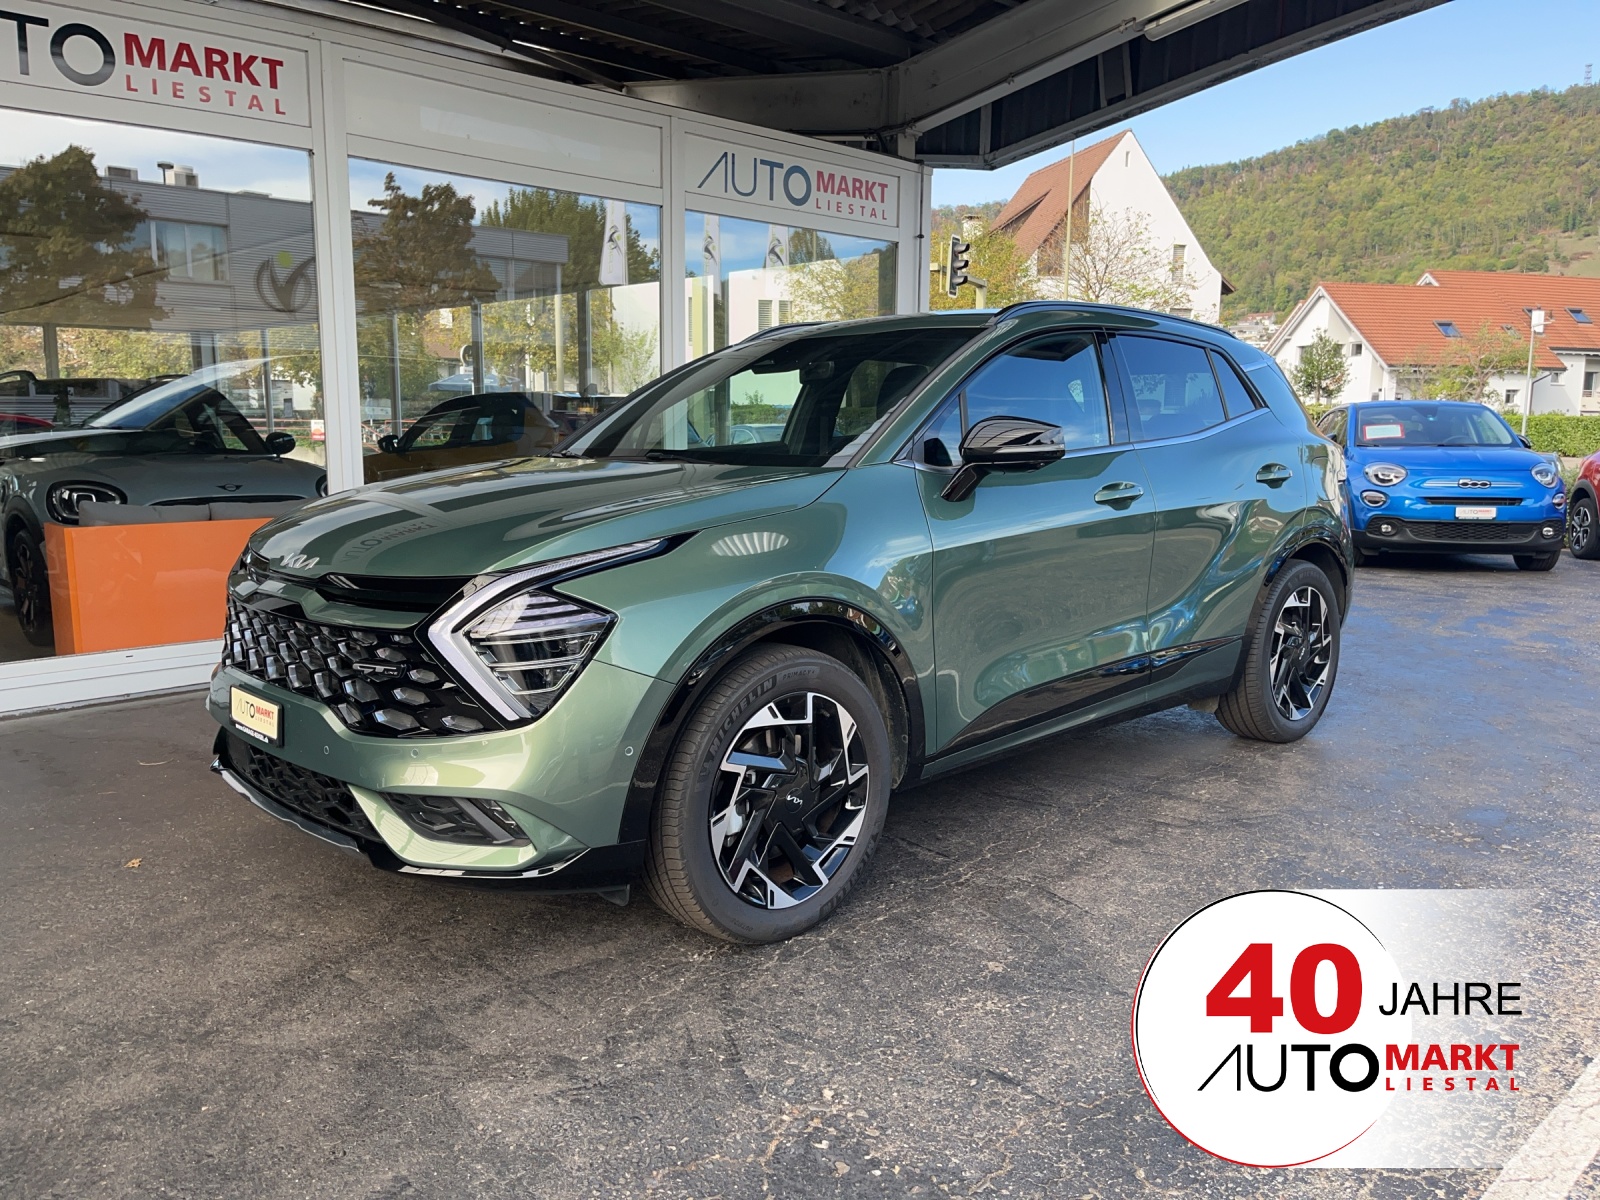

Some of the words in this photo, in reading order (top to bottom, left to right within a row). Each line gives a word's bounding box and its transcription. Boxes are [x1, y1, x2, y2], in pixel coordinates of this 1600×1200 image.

[124, 32, 284, 90] MARKT
[125, 74, 286, 116] LIESTAL
[697, 151, 812, 207] AUTO
[816, 170, 889, 204] MARKT
[815, 197, 888, 221] LIESTAL
[1458, 478, 1491, 489] 500
[709, 677, 775, 756] MICHELIN
